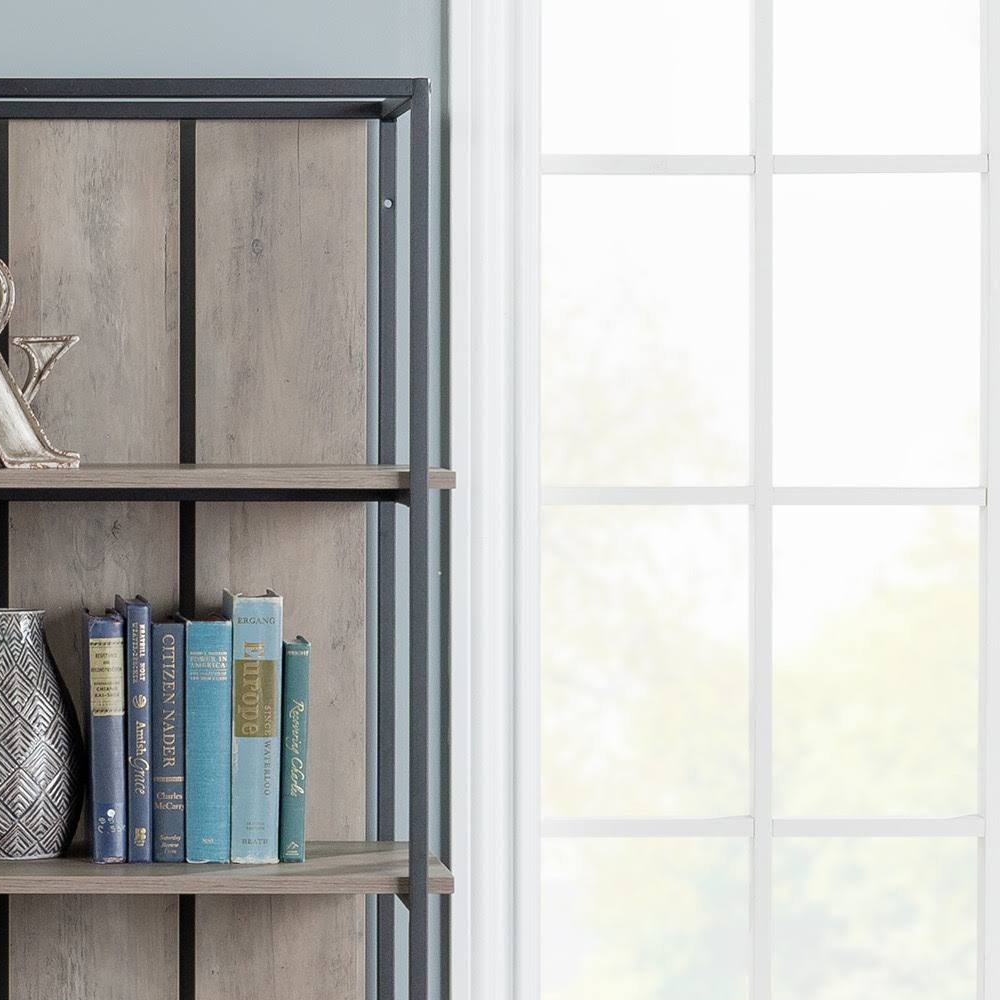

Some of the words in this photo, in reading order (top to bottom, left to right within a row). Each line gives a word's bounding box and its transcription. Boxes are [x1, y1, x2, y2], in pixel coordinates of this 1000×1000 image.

[237, 616, 276, 625] ERGANG
[162, 633, 176, 705] CITIZEN
[237, 640, 265, 736] Europe
[135, 720, 147, 756] Amish
[162, 708, 176, 769] NADER
[285, 699, 305, 755] Recovering
[129, 756, 150, 795] Grace
[156, 791, 183, 800] Charles
[263, 739, 273, 796] WATERLOO
